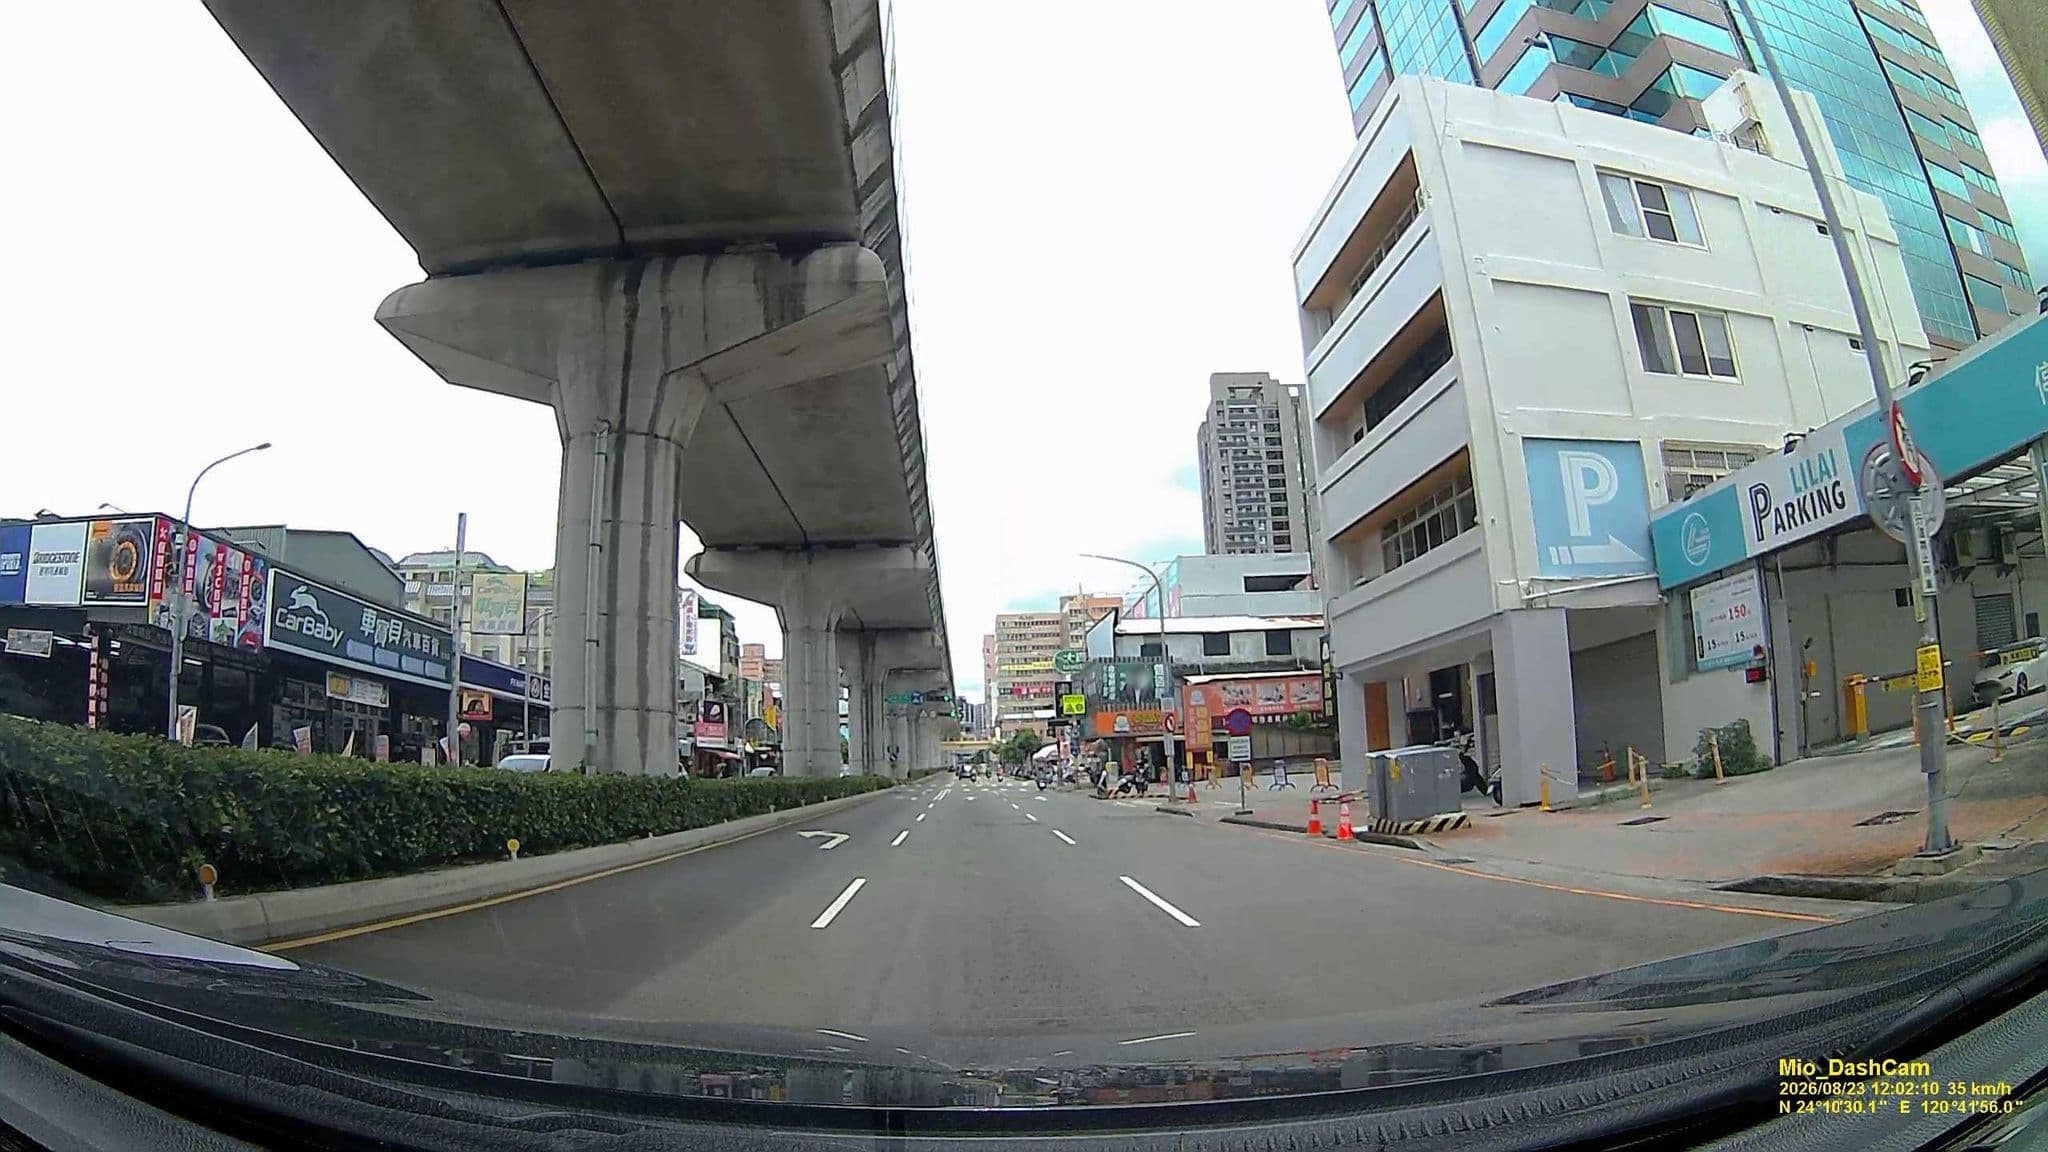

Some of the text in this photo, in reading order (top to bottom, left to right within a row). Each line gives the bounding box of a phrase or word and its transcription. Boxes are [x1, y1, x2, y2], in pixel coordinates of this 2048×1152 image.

[1790, 449, 1837, 493] LILAI
[1558, 451, 1618, 536] P
[1748, 480, 1846, 542] PARKING
[275, 607, 345, 648] CarBaby
[360, 608, 403, 648] 車寶貝
[1728, 603, 1746, 621] 150
